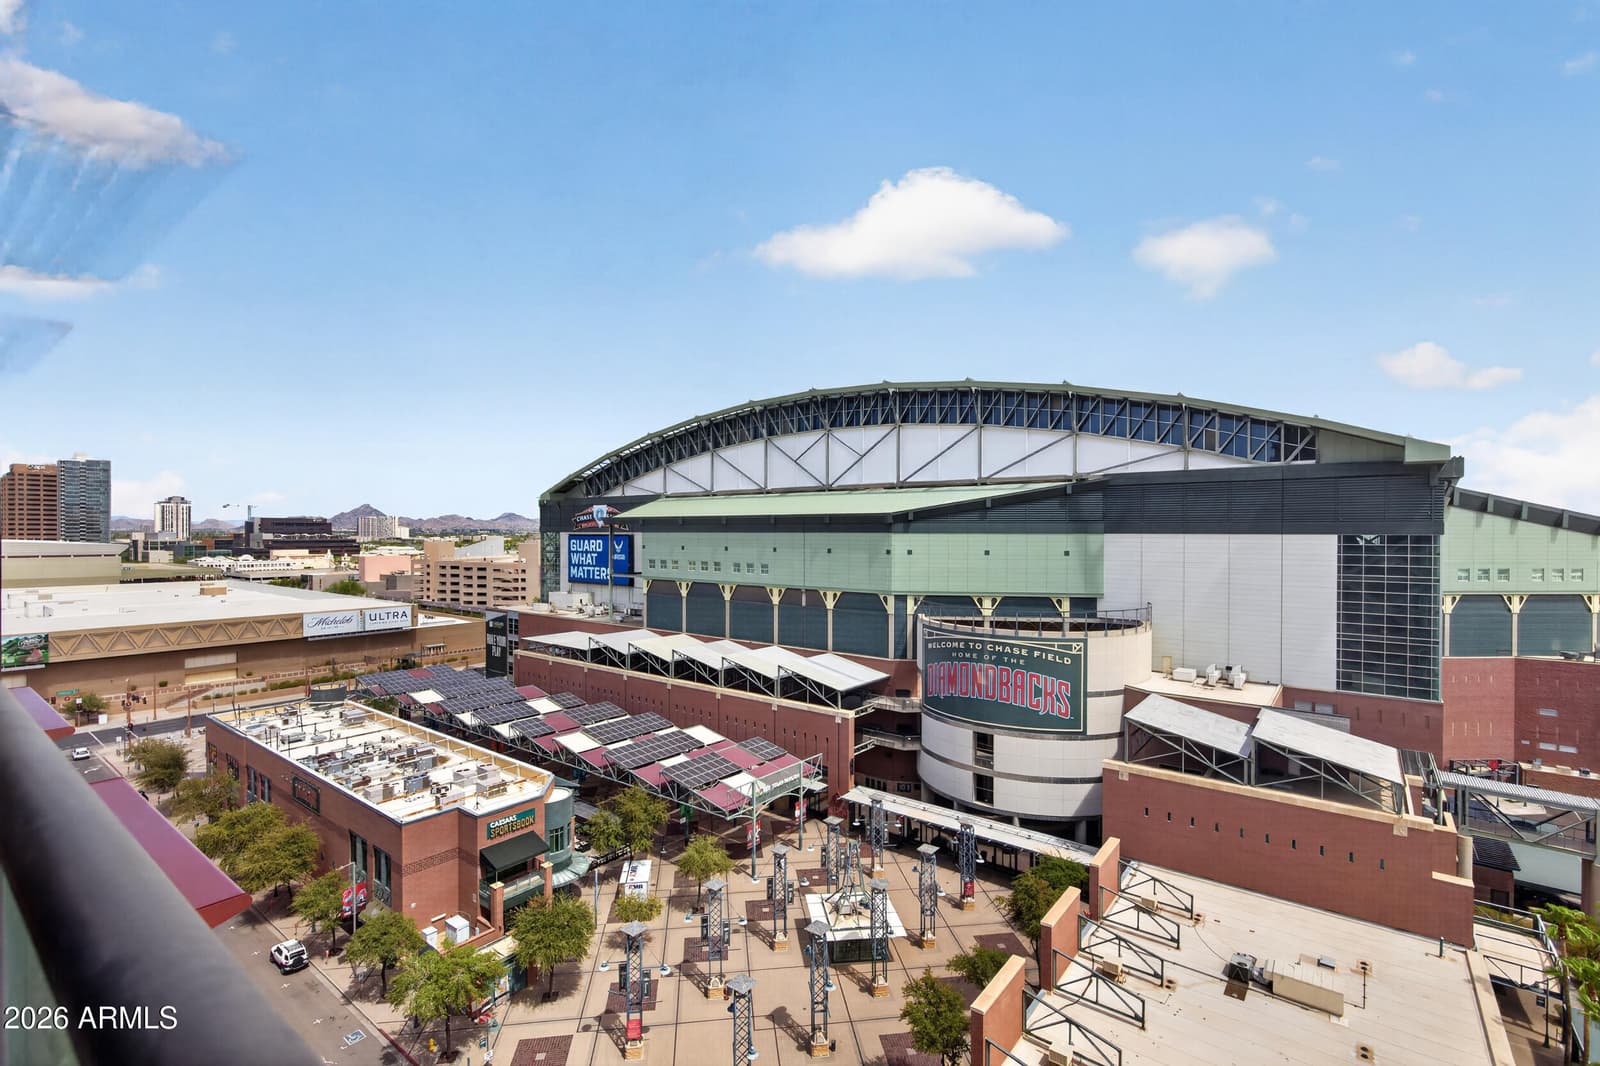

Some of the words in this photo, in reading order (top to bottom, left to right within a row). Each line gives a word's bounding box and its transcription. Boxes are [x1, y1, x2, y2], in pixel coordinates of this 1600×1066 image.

[570, 539, 603, 552] GUARD
[571, 552, 598, 565] WHAT
[369, 610, 408, 622] ULTRA
[927, 641, 965, 649] WELCOME
[969, 642, 983, 650] TO
[986, 643, 1029, 656] CHASE
[1033, 651, 1072, 665] FIELD
[951, 652, 978, 660] HOME
[1004, 656, 1025, 665] THE
[927, 661, 1071, 720] DIAMONDBACKS
[490, 814, 517, 828] CAESARS
[490, 816, 535, 838] SPORTSBOOK
